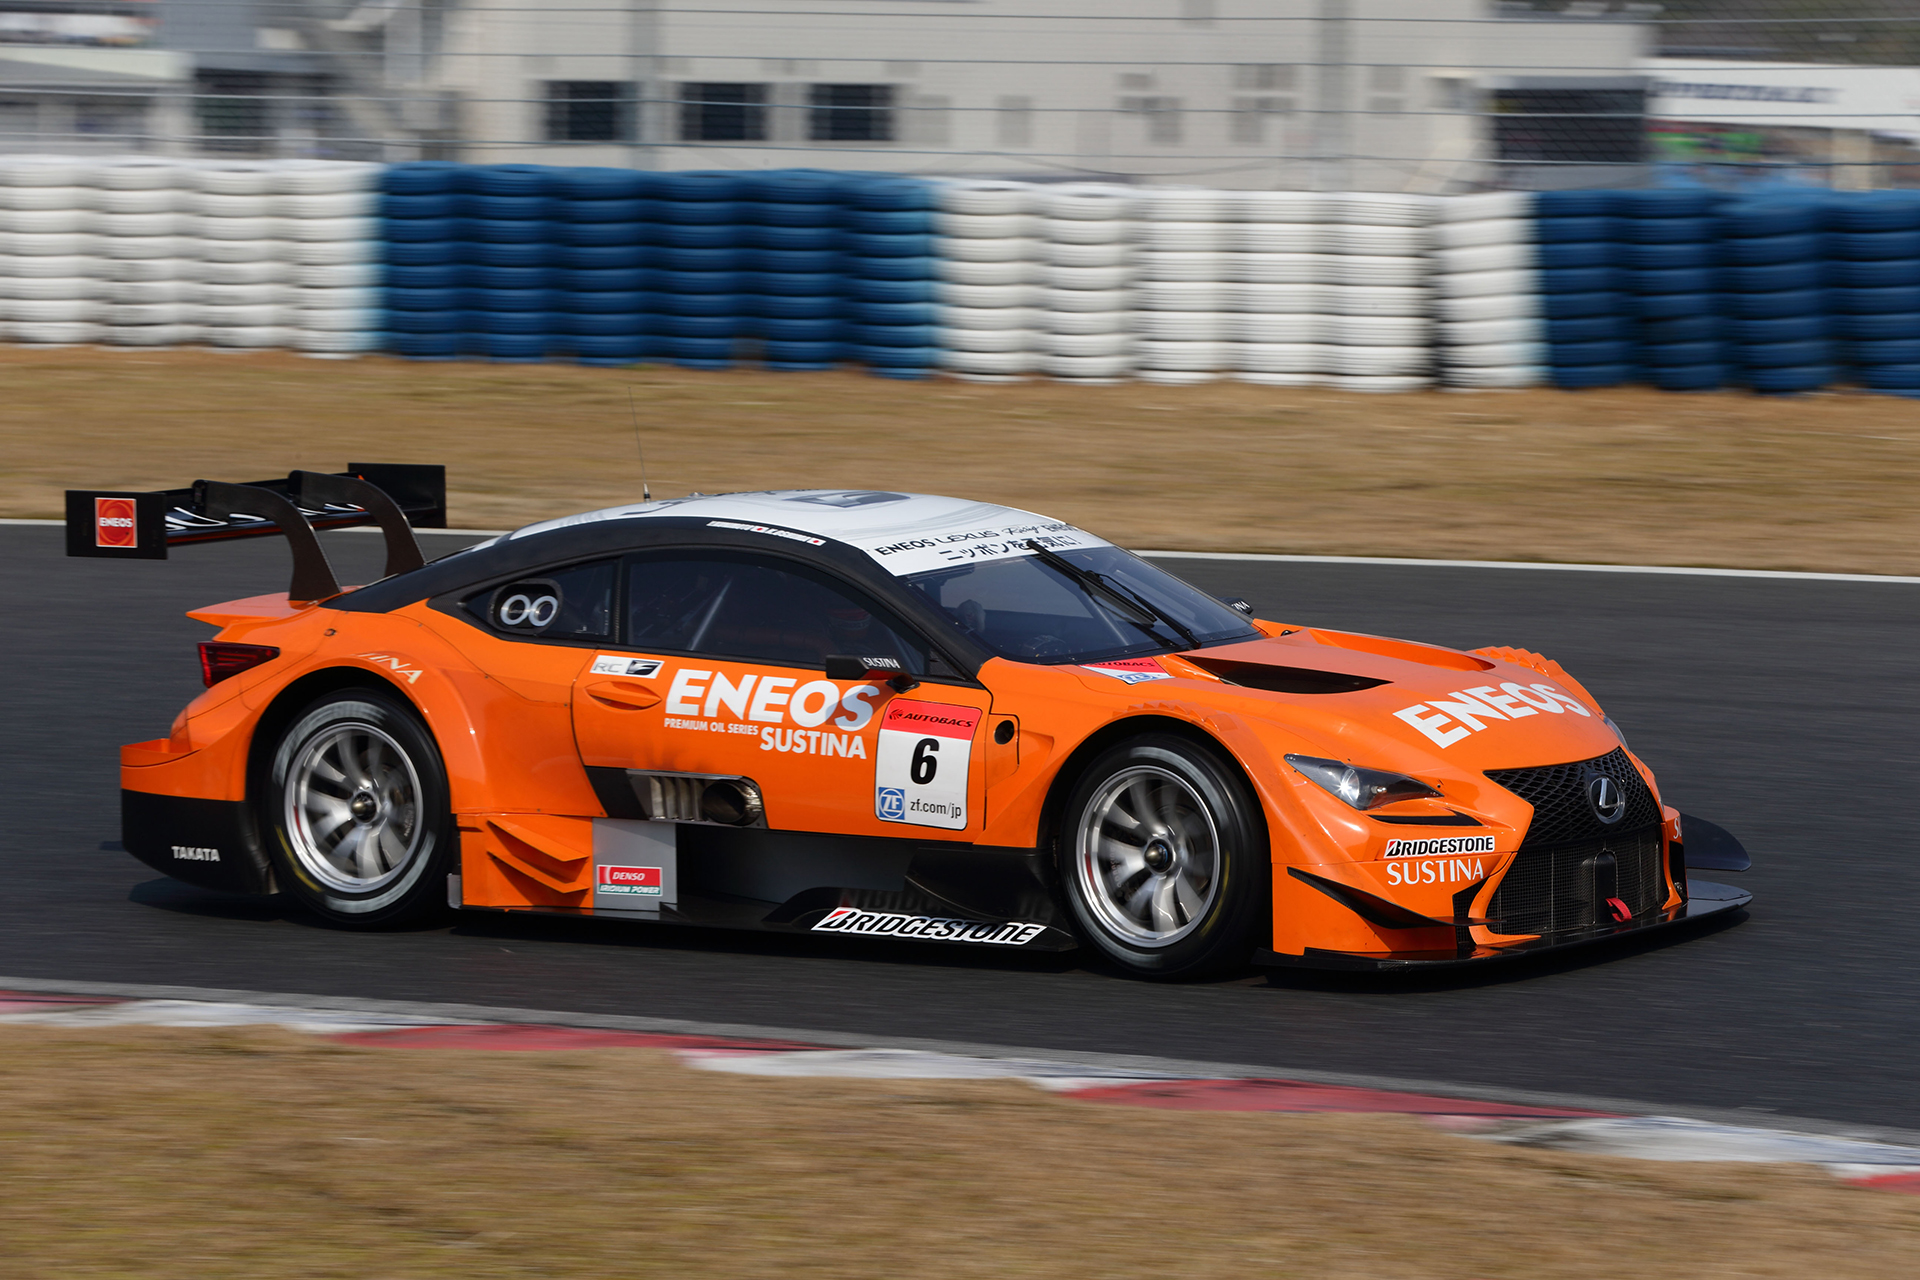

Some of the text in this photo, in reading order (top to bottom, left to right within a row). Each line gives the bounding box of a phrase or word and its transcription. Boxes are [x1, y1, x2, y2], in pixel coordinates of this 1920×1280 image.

[99, 517, 133, 528] ENEOS
[874, 538, 937, 556] ENEOS
[935, 531, 1000, 544] LEXUS
[1001, 525, 1039, 536] Racing
[592, 662, 622, 673] RC
[862, 657, 901, 669] SUSTINA
[665, 668, 880, 732] ENEOS
[904, 712, 974, 728] AUTOBACS
[1392, 682, 1591, 749] ENEOS
[664, 717, 759, 735] PREMIUM OIL SERIES
[760, 726, 867, 759] SUSTINA
[910, 737, 940, 785] 6
[910, 799, 962, 819] zf.com/jp
[171, 845, 221, 862] TAKATA
[1385, 837, 1494, 857] BRIDGESTONE
[612, 872, 645, 881] DENSO
[1386, 858, 1484, 886] SUSTINA
[631, 886, 660, 894] POWER
[812, 907, 1046, 944] BRIDGESTONE
